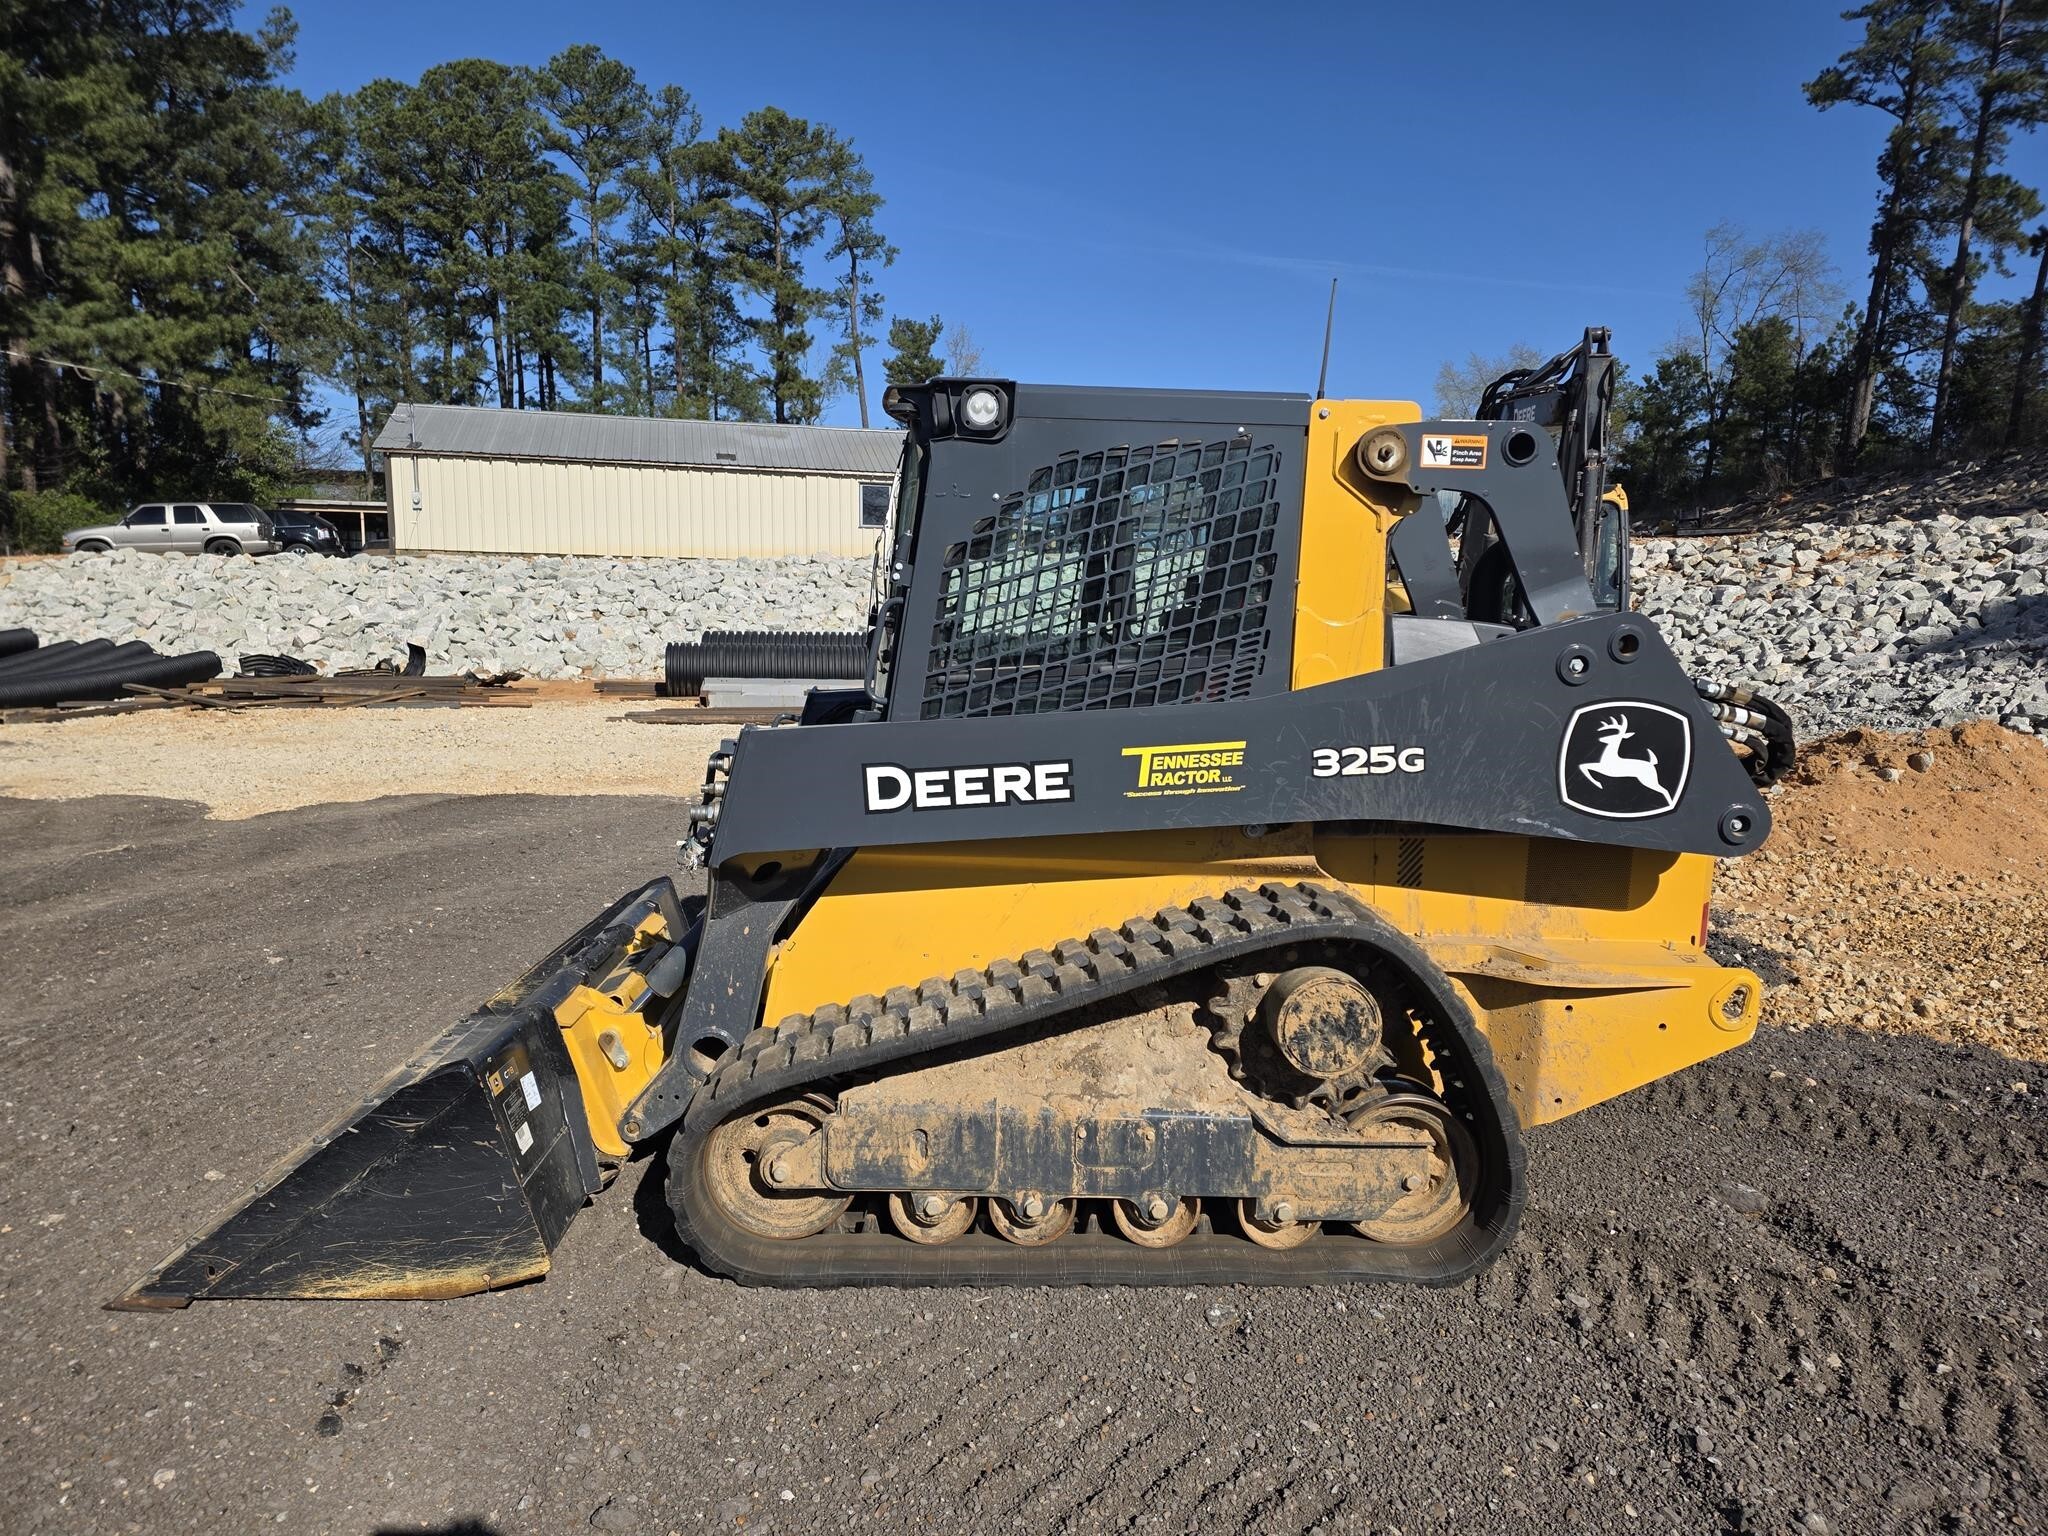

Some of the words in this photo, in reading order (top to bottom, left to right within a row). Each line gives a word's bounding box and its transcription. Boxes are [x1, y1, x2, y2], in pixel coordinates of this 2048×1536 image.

[1513, 404, 1537, 421] DEERE
[1121, 741, 1247, 776] TENNESSEE
[1313, 745, 1425, 777] 325G
[865, 762, 1071, 811] DEERE
